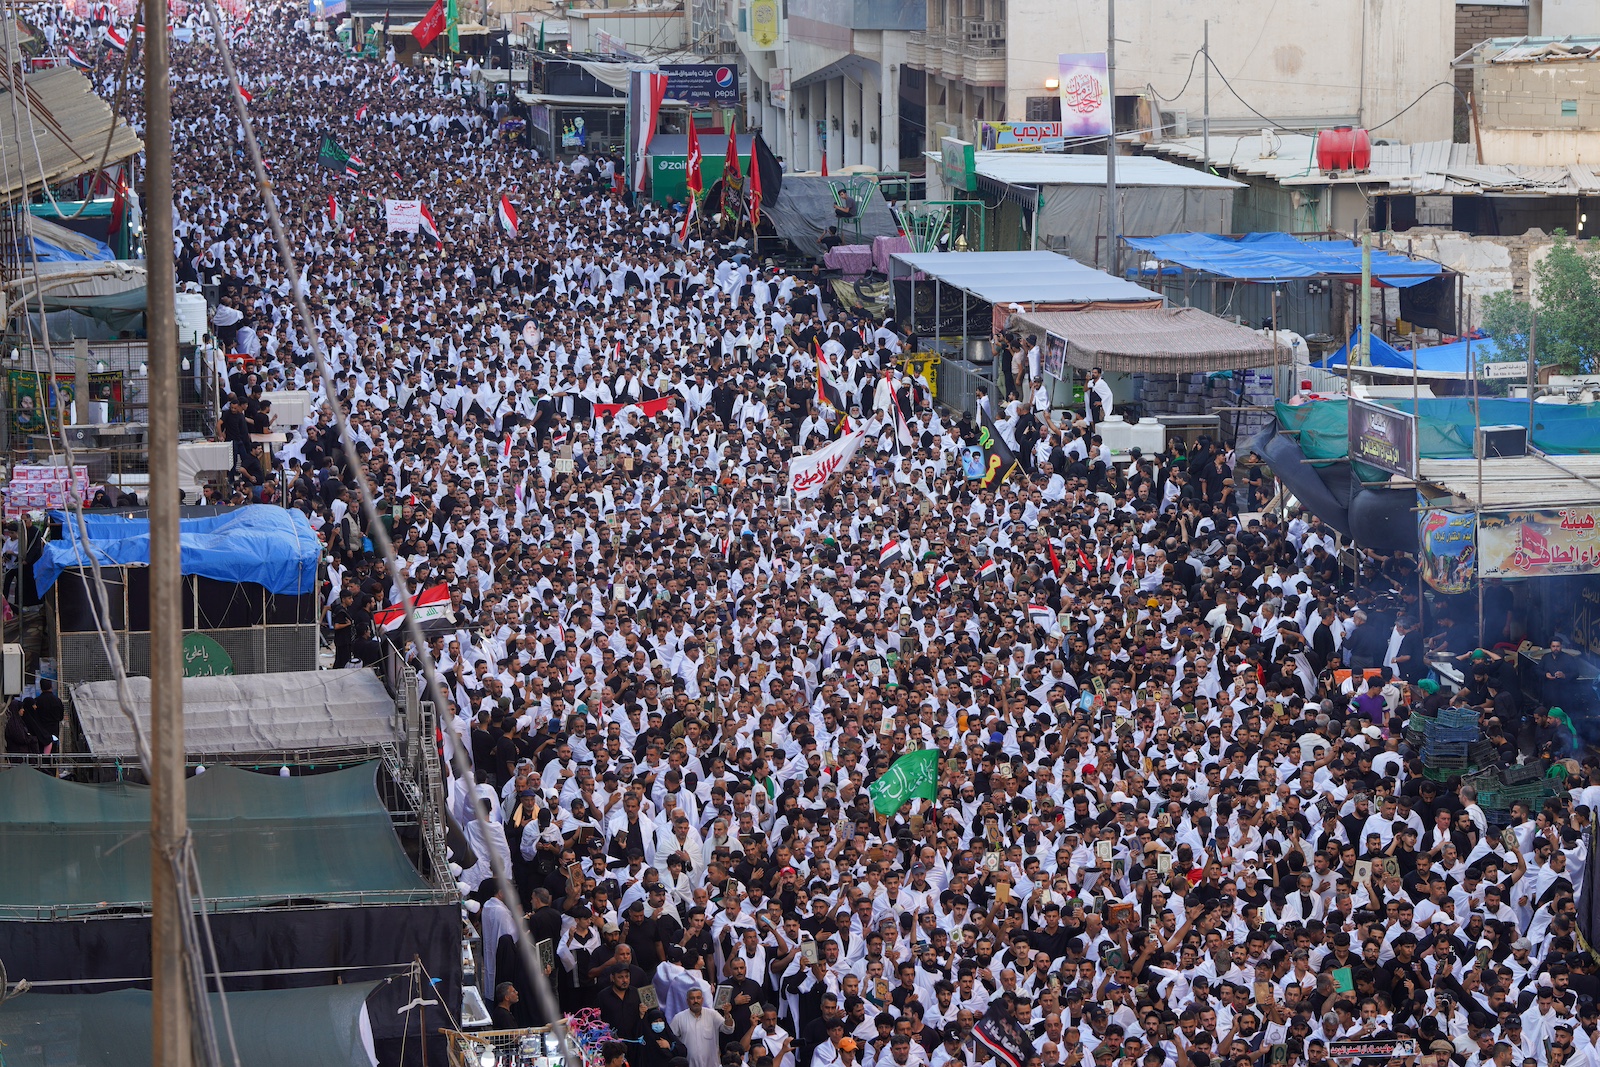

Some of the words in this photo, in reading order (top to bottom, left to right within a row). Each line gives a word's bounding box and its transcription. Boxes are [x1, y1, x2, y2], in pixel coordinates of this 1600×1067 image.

[714, 89, 736, 98] pepsi
[1013, 122, 1063, 142] الاعرجي
[1559, 509, 1595, 535] هيئة
[1514, 545, 1579, 571] الطاهرة
